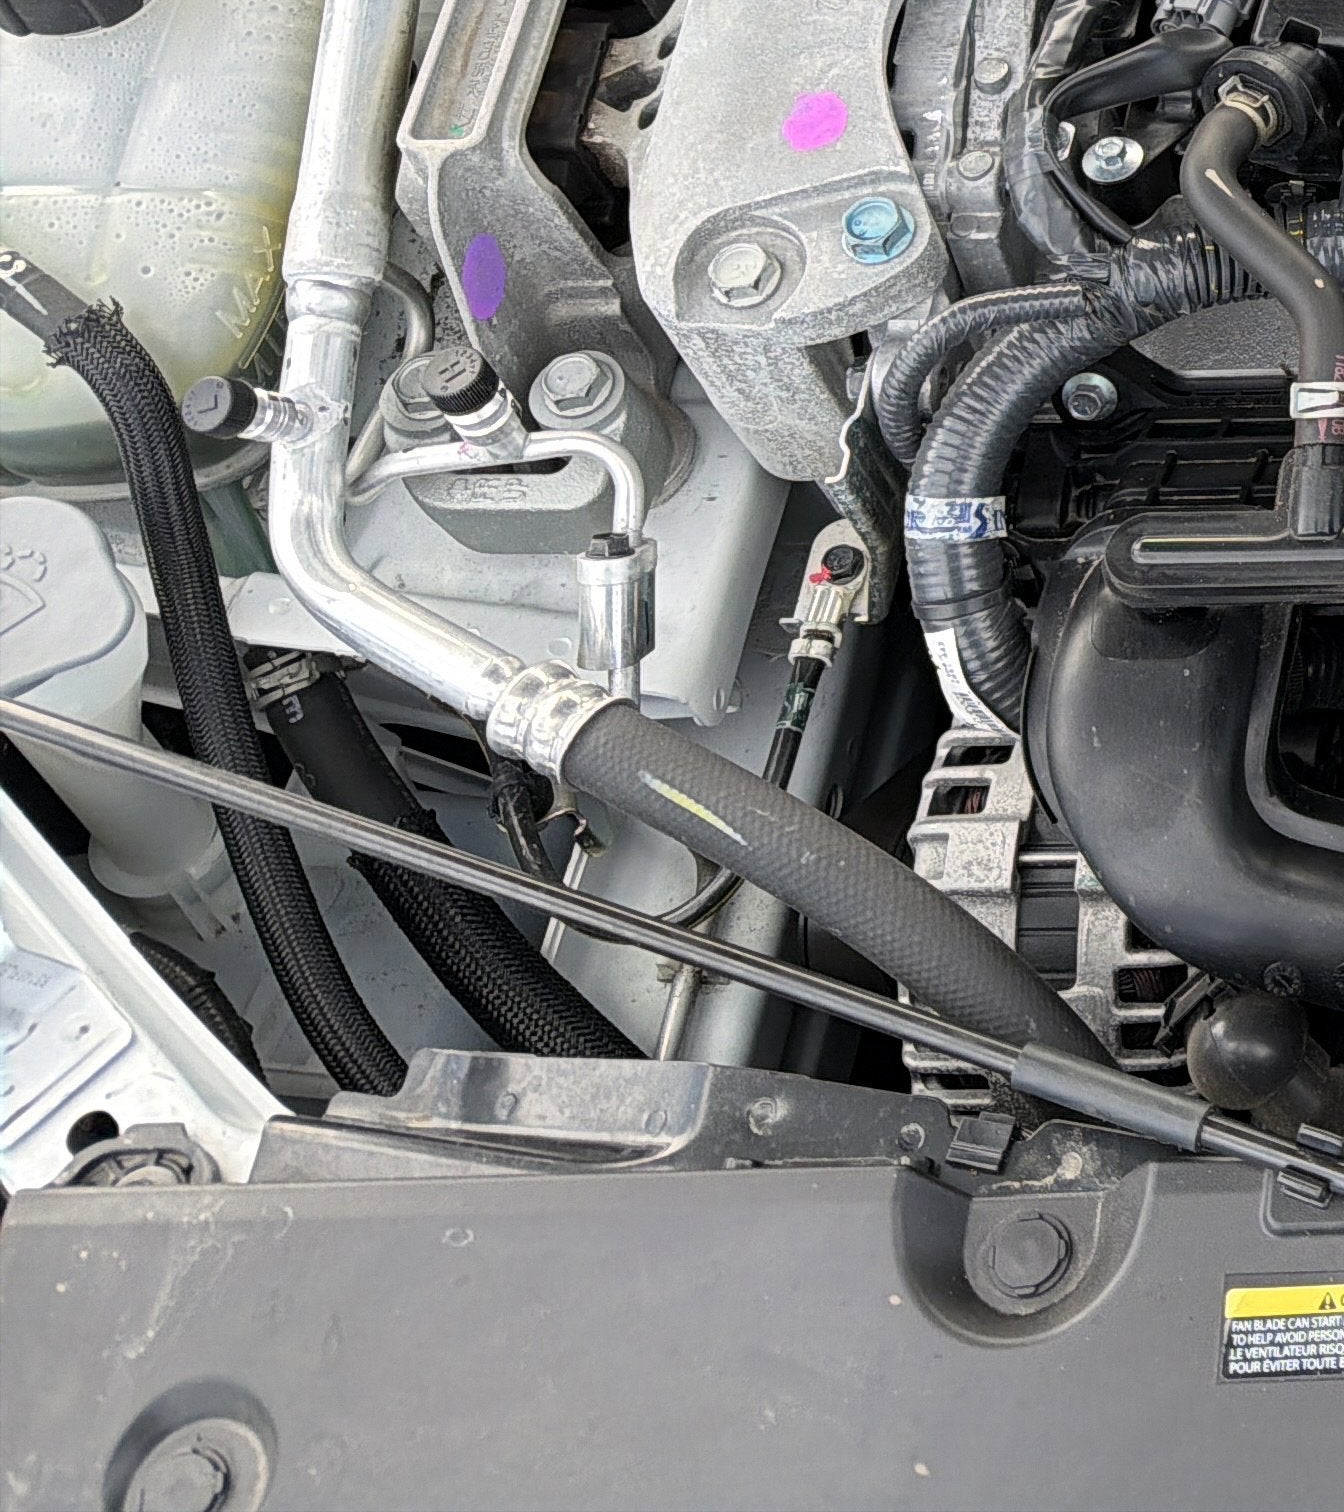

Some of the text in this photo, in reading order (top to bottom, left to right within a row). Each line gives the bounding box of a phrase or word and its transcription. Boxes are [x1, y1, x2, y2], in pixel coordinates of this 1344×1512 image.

[215, 225, 282, 339] MAX
[1232, 1320, 1251, 1332] FAN
[1253, 1318, 1286, 1331] BLADE
[1288, 1317, 1309, 1329] CAN
[1311, 1315, 1342, 1328] START
[1231, 1333, 1246, 1346] TO
[1247, 1331, 1273, 1345] HELP
[1274, 1330, 1306, 1344] AVOID
[1230, 1348, 1244, 1360] LE
[1245, 1343, 1316, 1359] VENTILATEUR
[1229, 1361, 1260, 1374] POUR
[1263, 1357, 1299, 1372] ÉVITER
[1301, 1356, 1337, 1371] TOUTE
